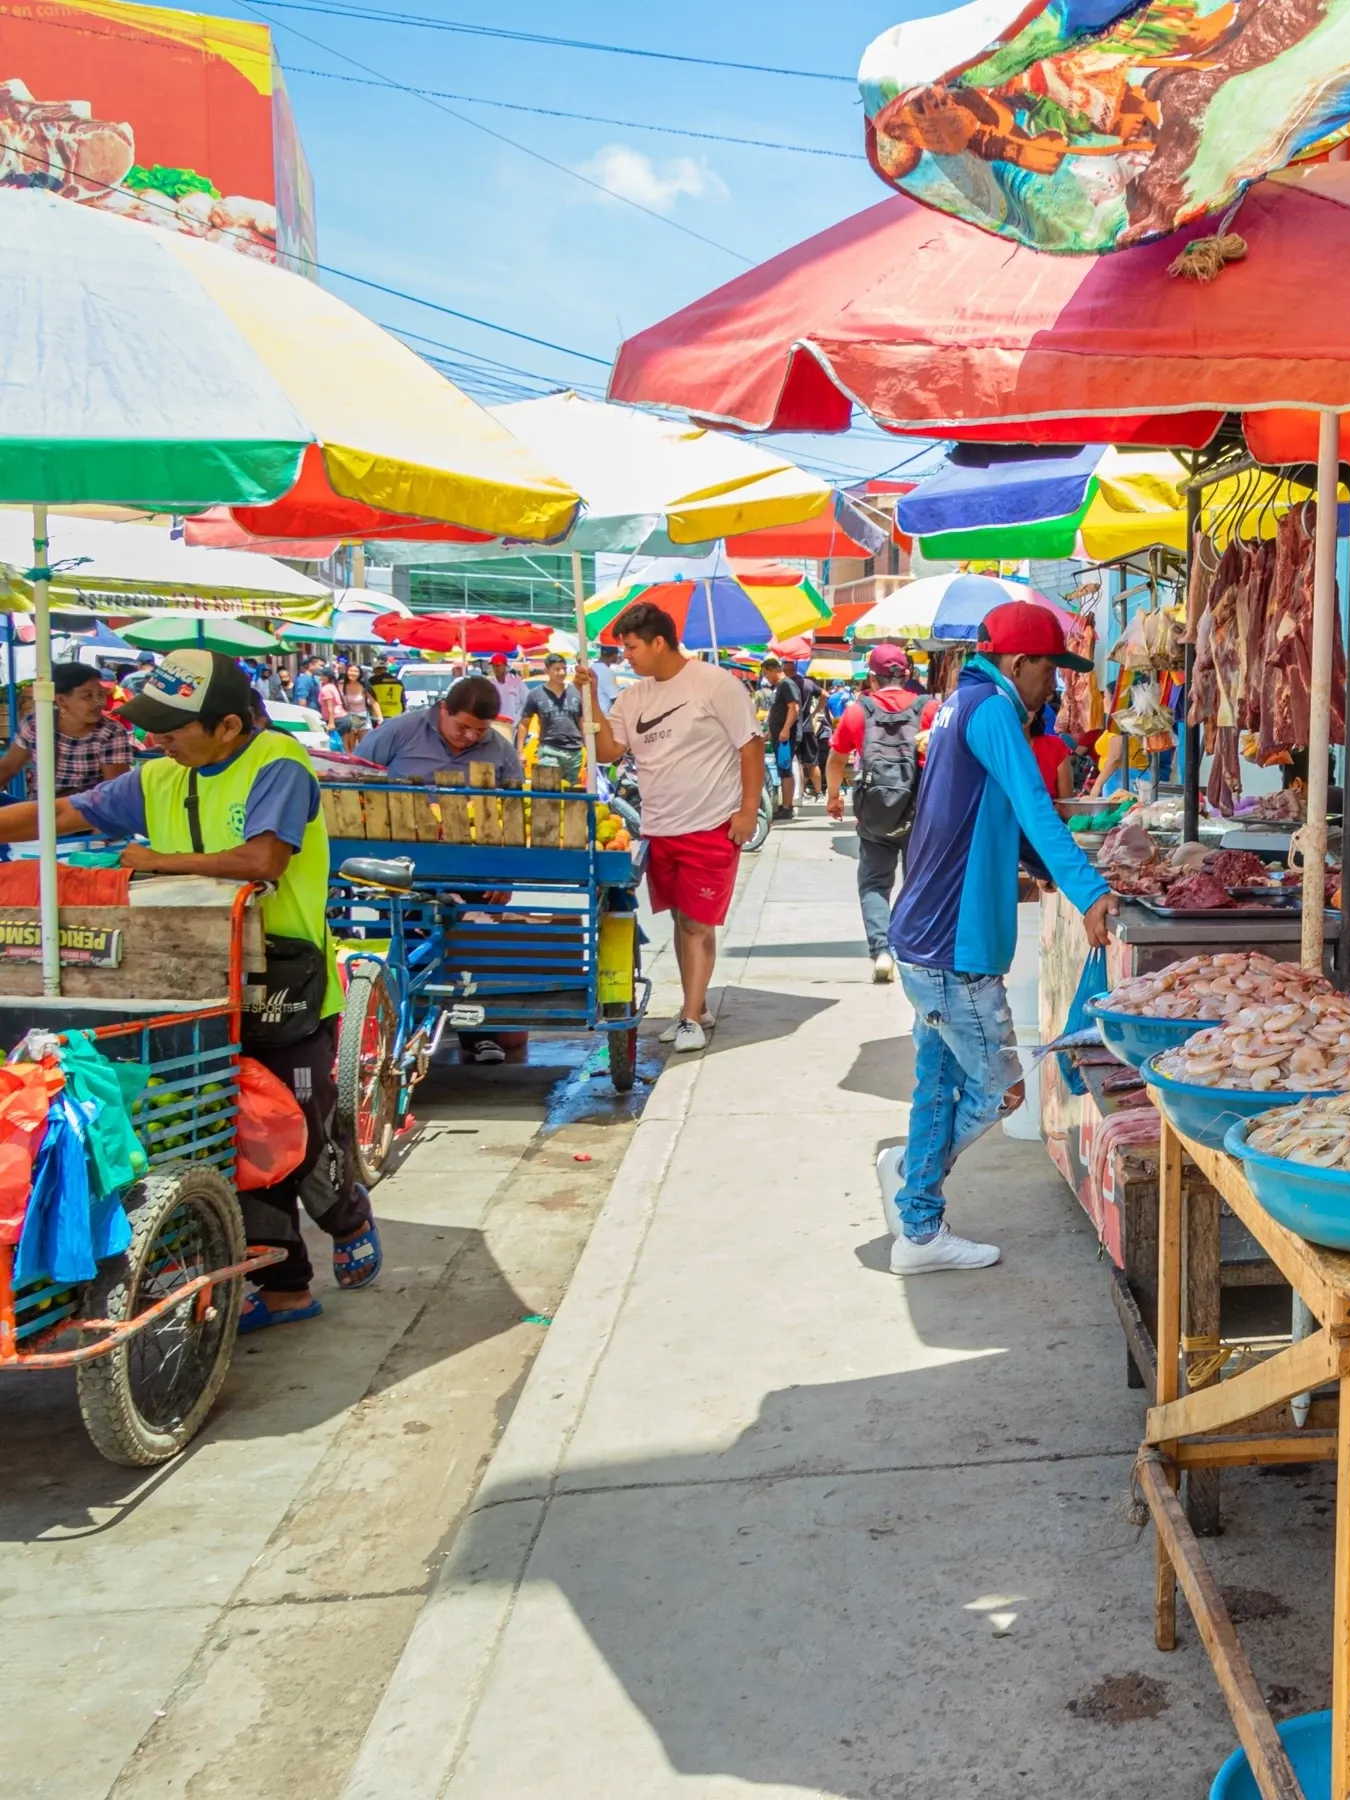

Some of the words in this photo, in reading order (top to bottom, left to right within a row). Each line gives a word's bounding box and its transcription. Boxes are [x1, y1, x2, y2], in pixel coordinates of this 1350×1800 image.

[386, 686, 394, 700] 4
[644, 732, 657, 743] JUST
[251, 1003, 294, 1013] SPORTS
